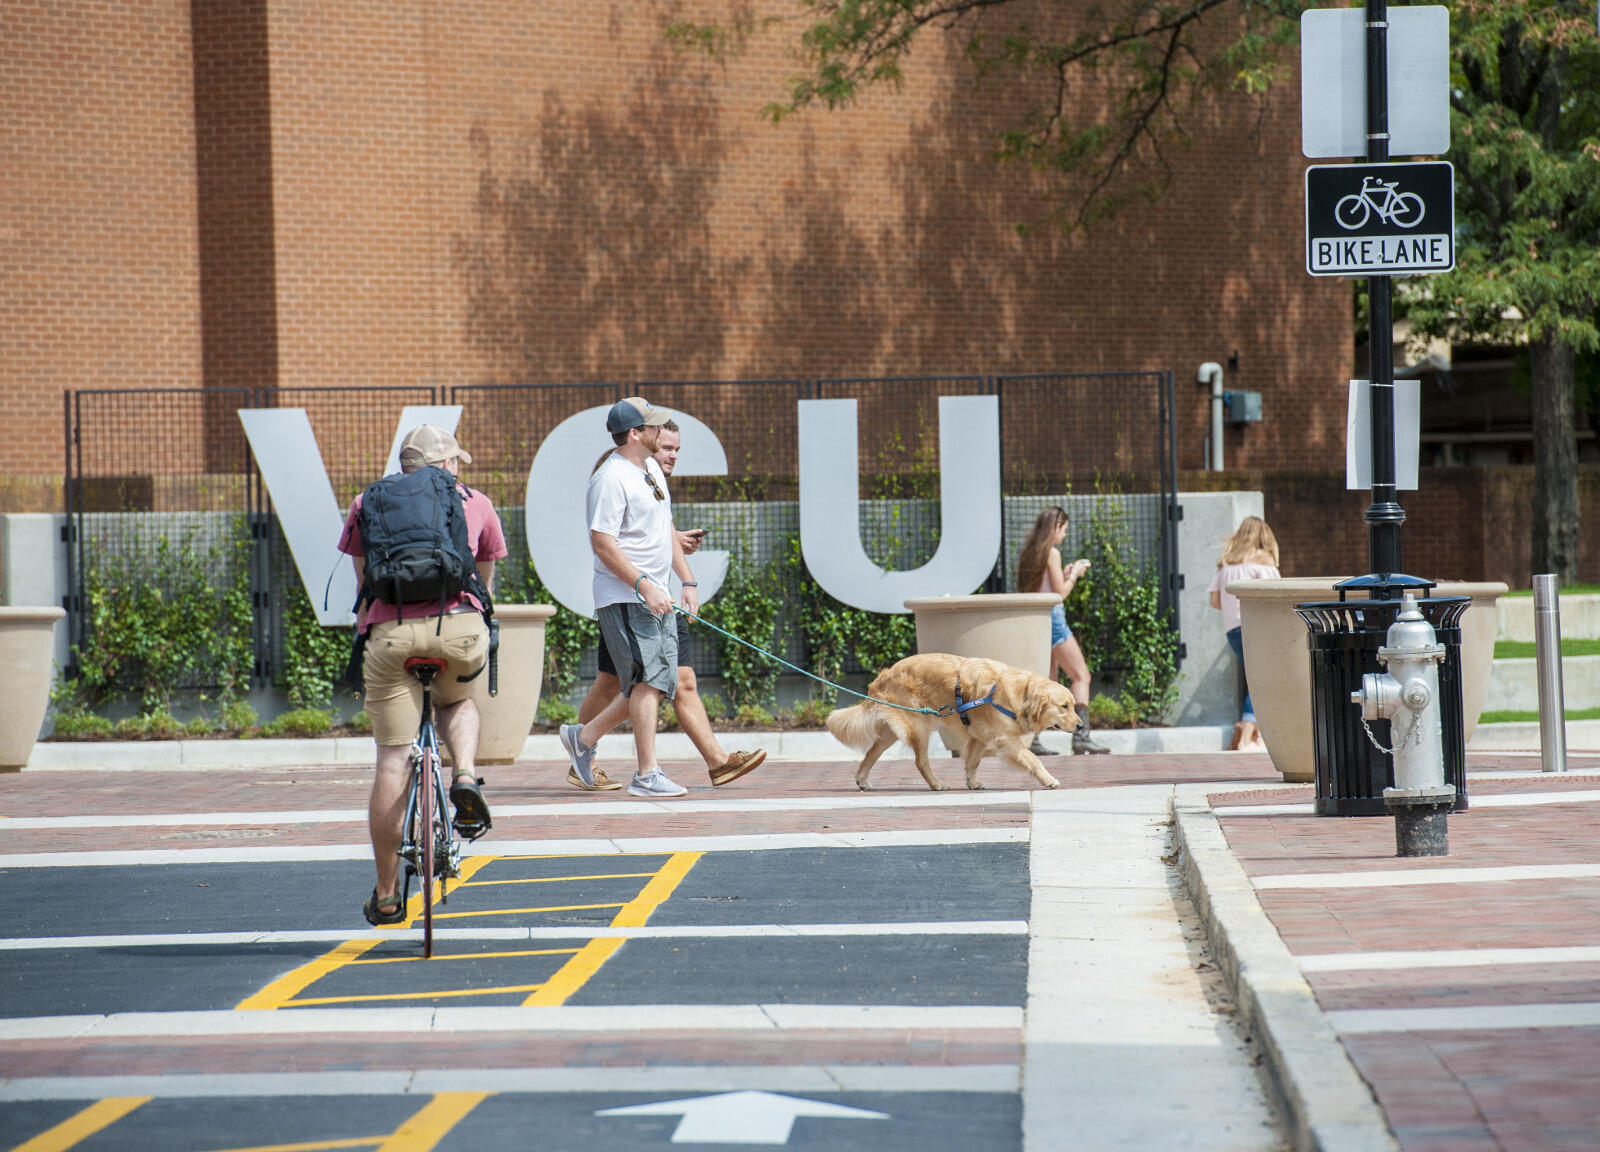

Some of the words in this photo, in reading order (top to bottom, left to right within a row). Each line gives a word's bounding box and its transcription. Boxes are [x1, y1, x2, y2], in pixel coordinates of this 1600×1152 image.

[1319, 241, 1374, 266] BIKE
[1382, 239, 1443, 263] LANE
[237, 394, 1002, 627] VCU
